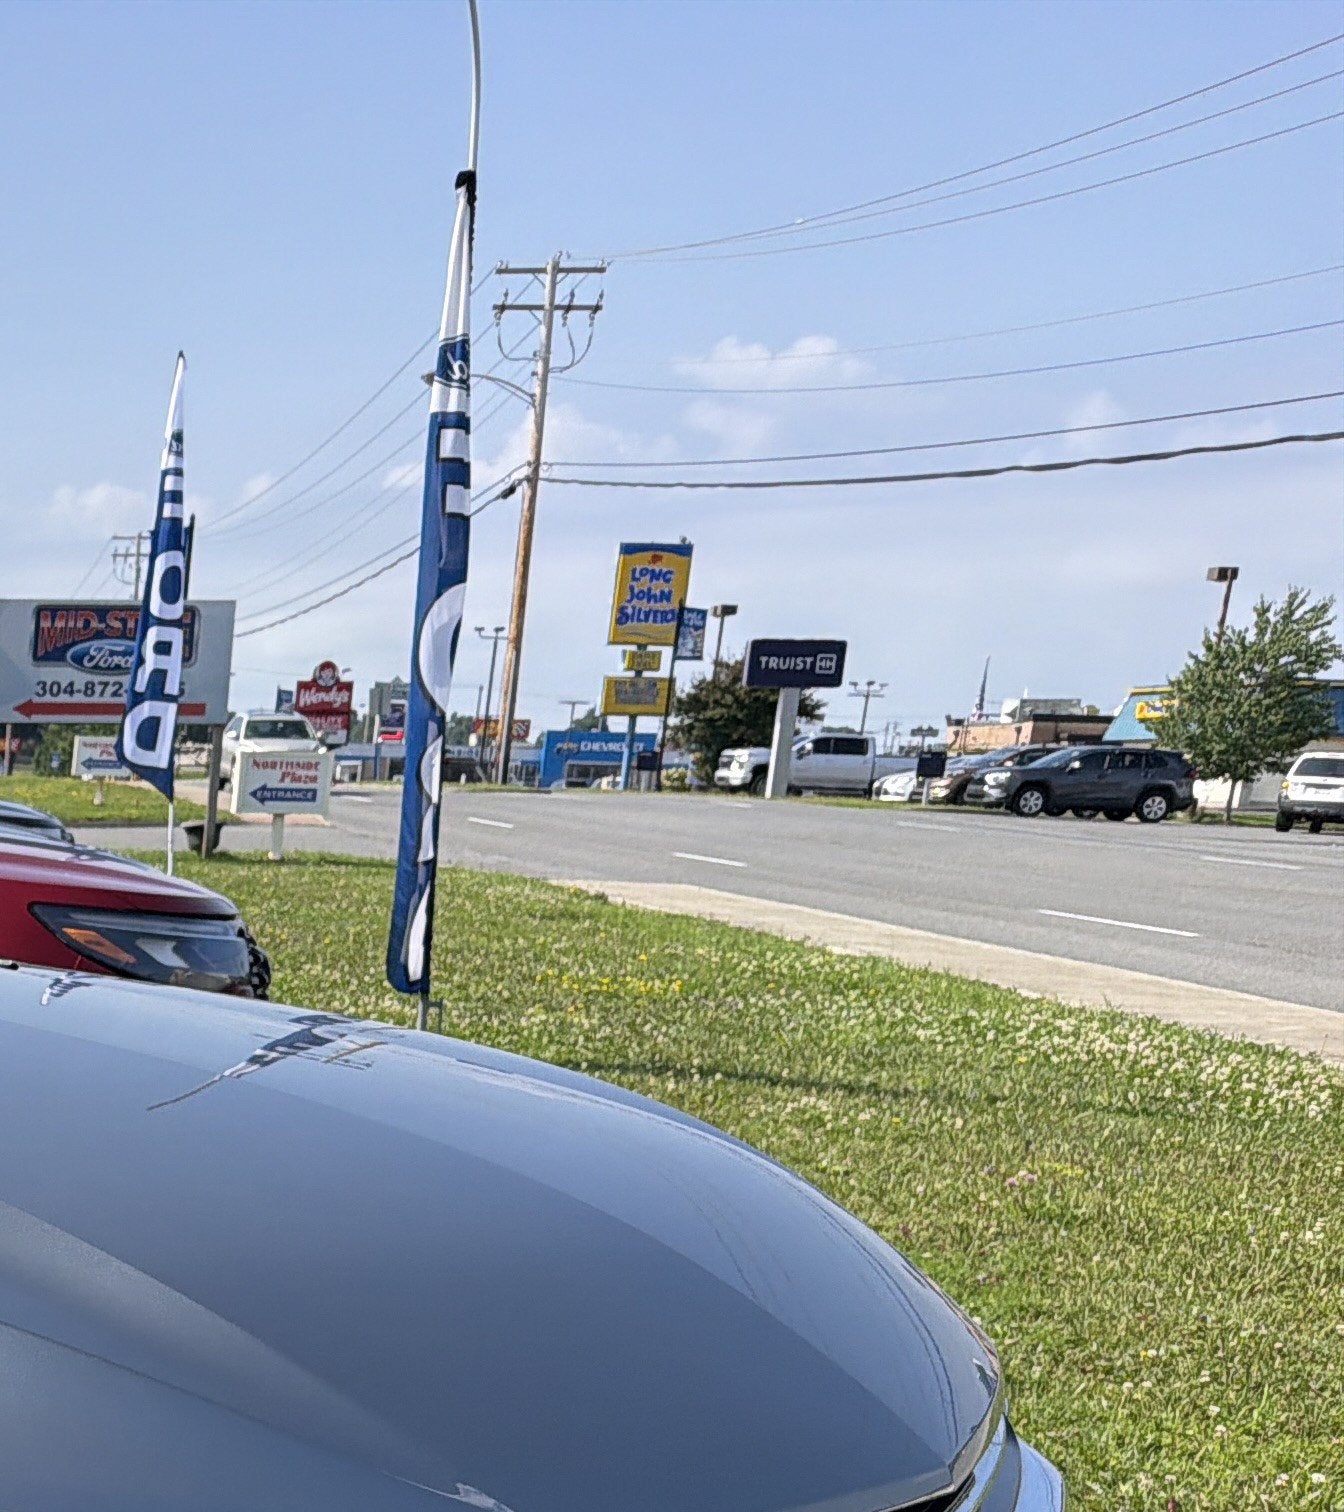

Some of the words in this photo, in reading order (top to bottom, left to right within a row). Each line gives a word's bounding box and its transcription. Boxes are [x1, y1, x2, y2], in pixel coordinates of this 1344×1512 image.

[759, 656, 814, 671] TRUIST
[299, 684, 351, 708] Wendy's
[252, 758, 321, 772] NORTHSIDE
[279, 771, 318, 784] Plaza
[256, 789, 313, 799] ENTRANCE
